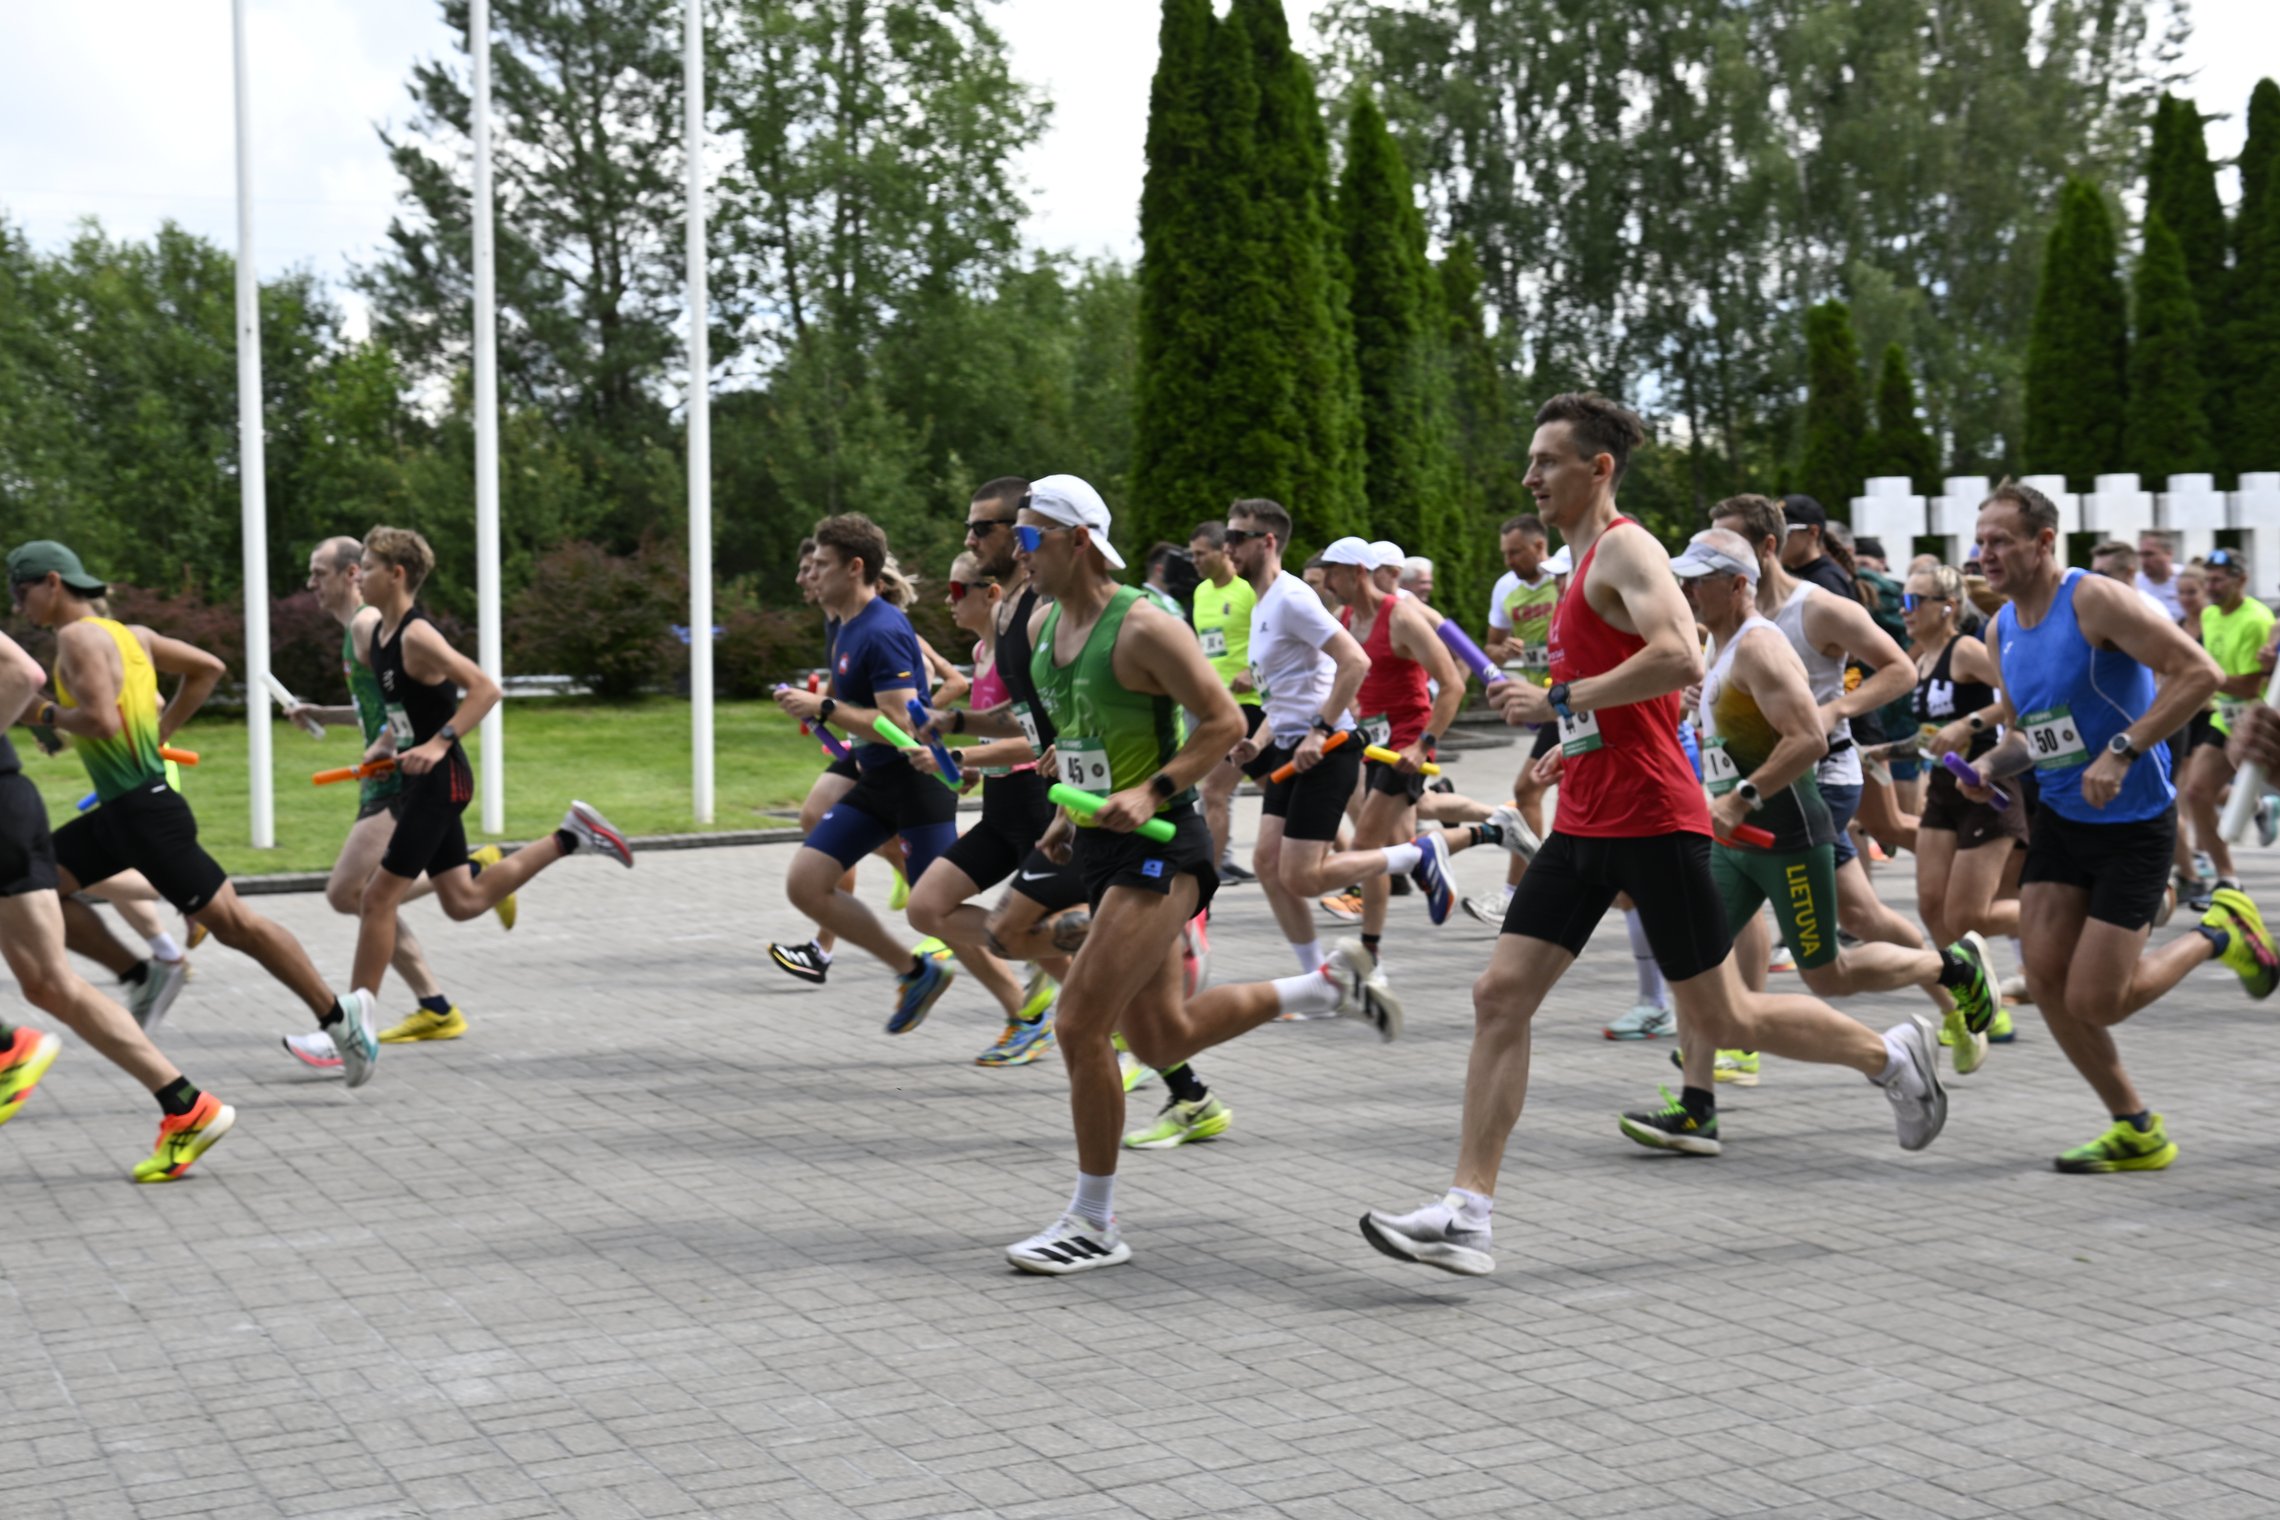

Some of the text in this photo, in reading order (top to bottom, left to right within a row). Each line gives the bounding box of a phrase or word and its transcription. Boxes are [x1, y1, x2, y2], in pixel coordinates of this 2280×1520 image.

[2034, 727, 2059, 753] 50
[1067, 756, 1085, 785] 45
[1785, 863, 1822, 958] LIETUVA
